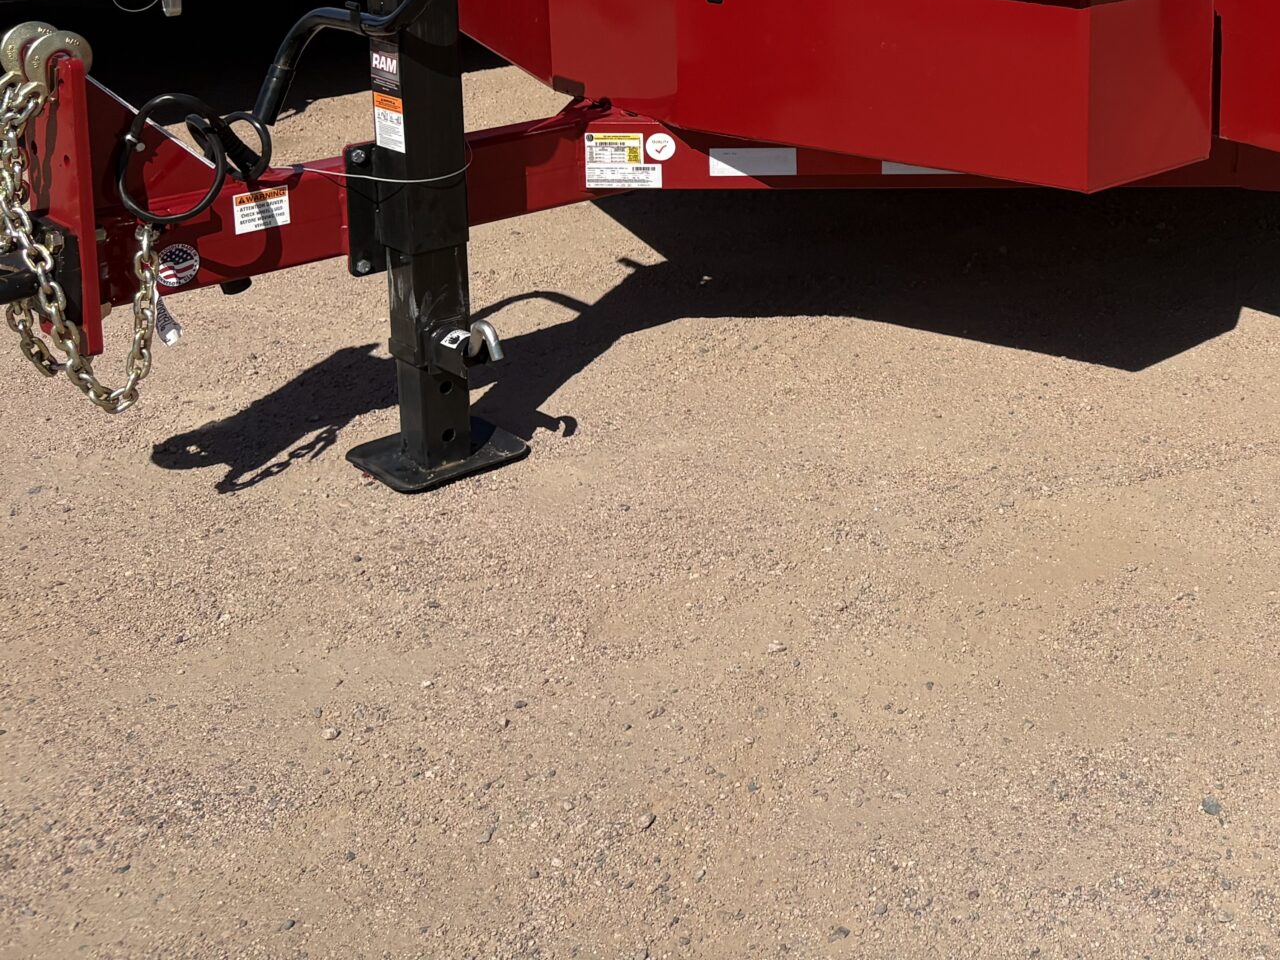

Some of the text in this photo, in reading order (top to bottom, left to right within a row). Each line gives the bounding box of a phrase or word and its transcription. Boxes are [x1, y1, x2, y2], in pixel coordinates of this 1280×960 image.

[372, 52, 397, 74] RAM
[246, 189, 285, 203] WARNING
[240, 199, 284, 212] ATTENTION DRIVER
[240, 217, 256, 225] BEFORE
